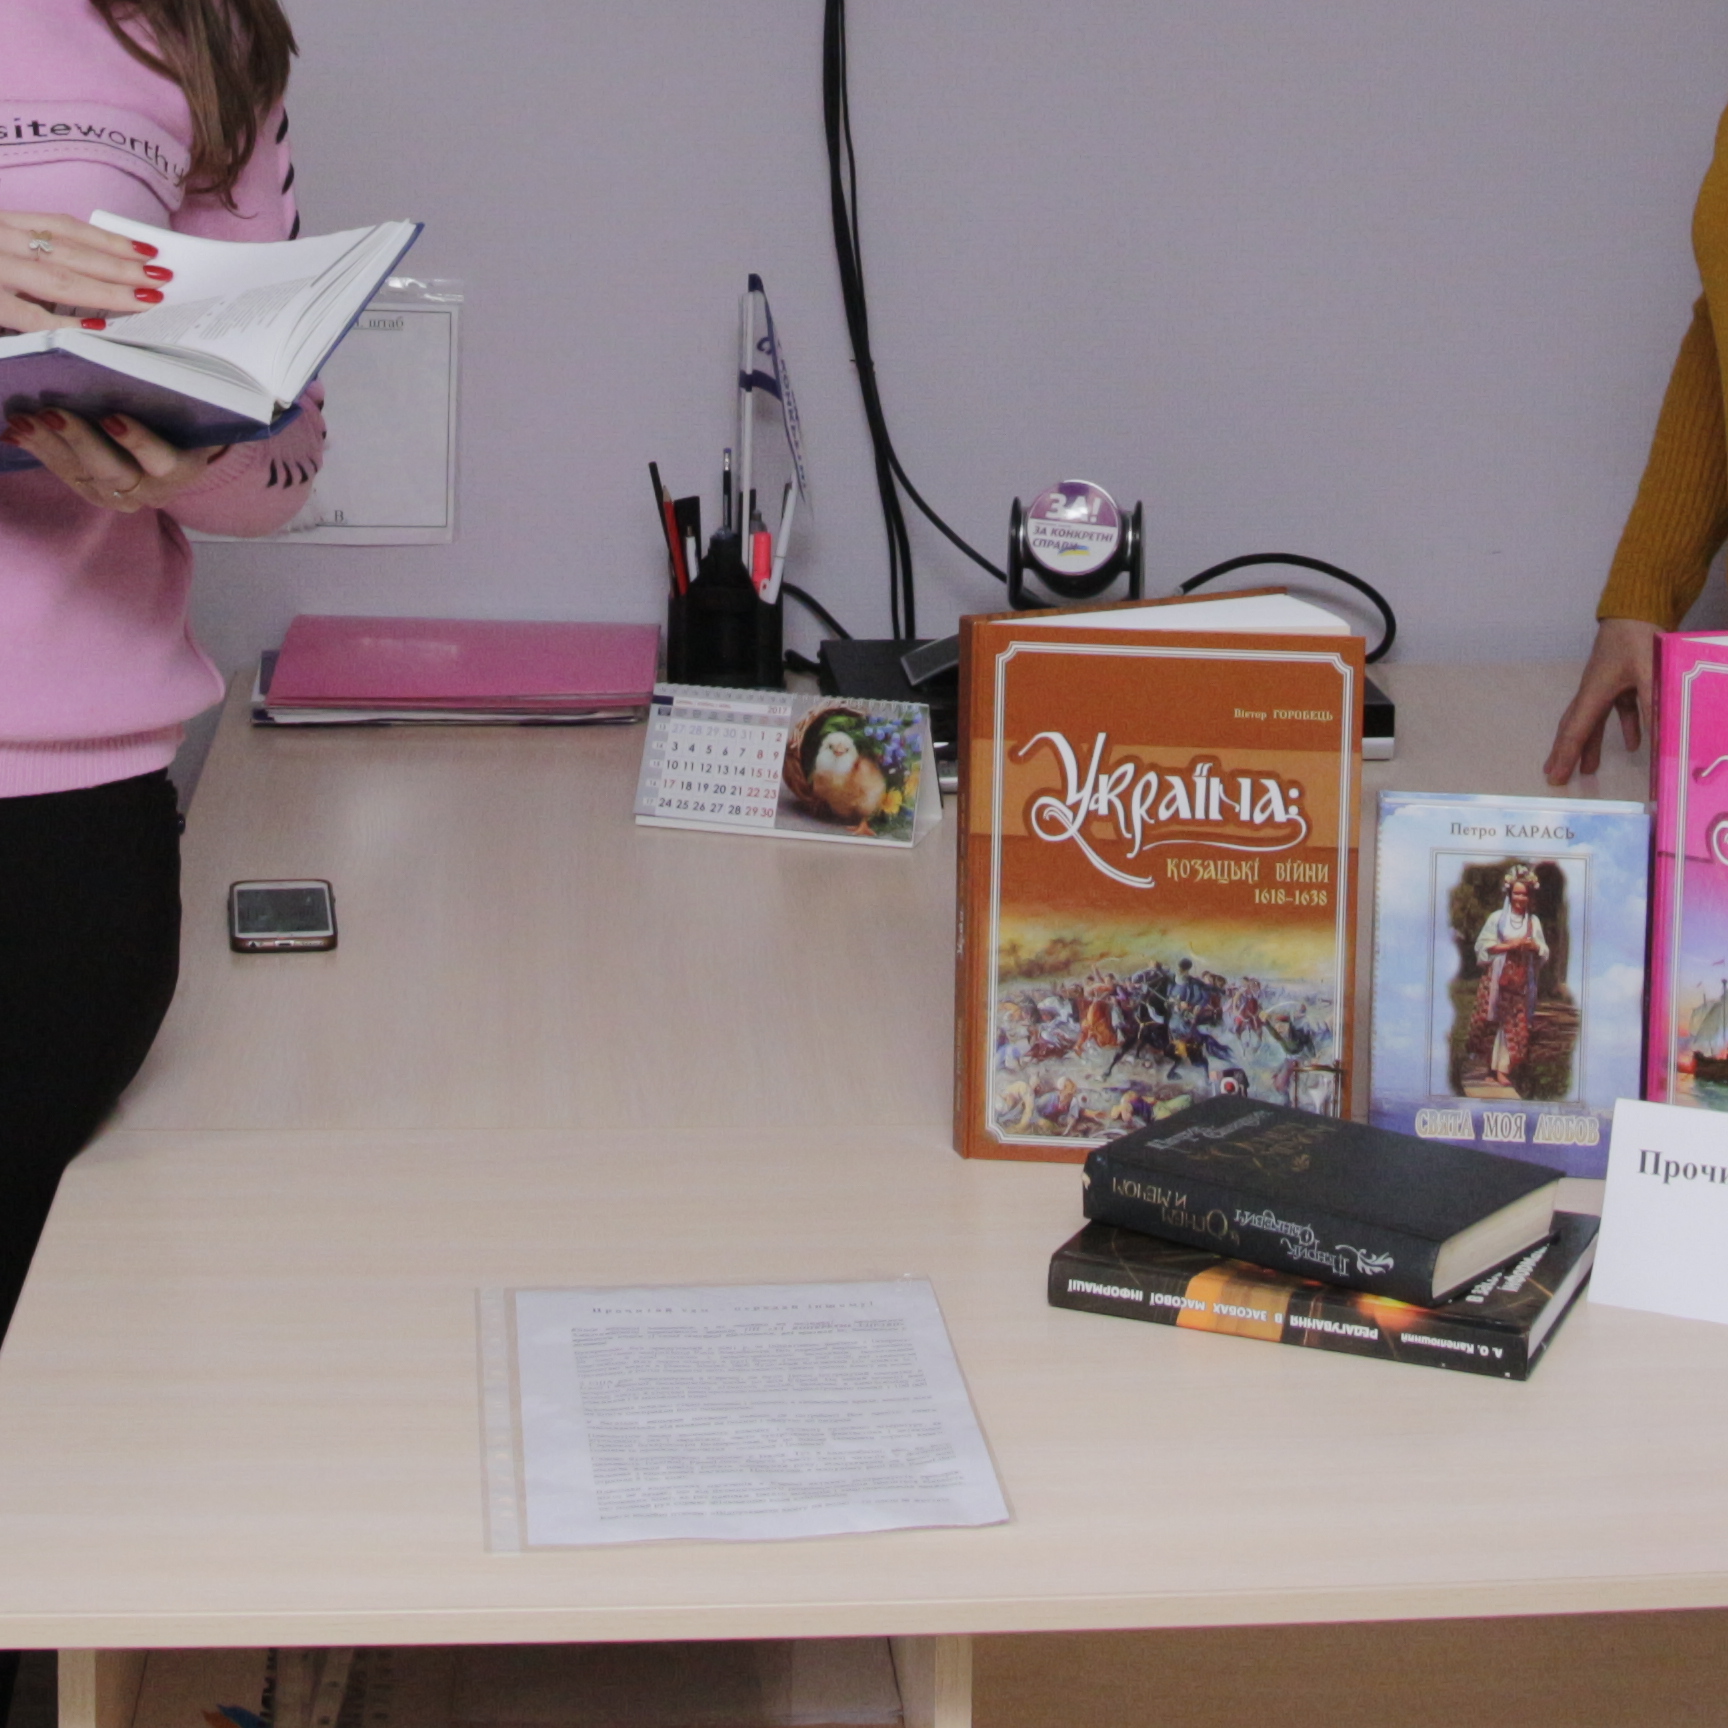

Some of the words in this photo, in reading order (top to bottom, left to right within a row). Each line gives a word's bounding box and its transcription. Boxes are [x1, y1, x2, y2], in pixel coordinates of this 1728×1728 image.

[1045, 493, 1101, 523] ЗА!
[1034, 526, 1047, 535] ЗА
[1051, 528, 1114, 542] КОНКРЕТНІ
[1234, 707, 1267, 721] Віктор
[1273, 709, 1334, 722] ГОРОБЕЦЬ
[761, 731, 765, 740] 1
[776, 732, 782, 742] 2
[672, 741, 678, 751] 3
[689, 743, 695, 752] 4
[706, 745, 712, 754] 5
[722, 747, 728, 756] 6
[739, 747, 746, 757] 7
[757, 749, 763, 760] 8
[773, 751, 779, 761] 9
[667, 760, 679, 770] 10
[684, 761, 694, 771] 11
[701, 763, 712, 773] 12
[717, 764, 729, 775] 13
[734, 765, 745, 776] 14
[751, 767, 762, 778] 15
[766, 769, 778, 779] 16
[663, 779, 676, 788] 17
[681, 781, 692, 791] 18
[697, 782, 709, 792] 19
[713, 784, 726, 794] 20
[730, 785, 742, 796] 21
[746, 787, 760, 798] 22
[763, 788, 777, 799] 23
[658, 797, 672, 808] 24
[676, 799, 689, 809] 25
[692, 801, 705, 811] 26
[710, 803, 724, 813] 27
[728, 804, 741, 815] 28
[745, 806, 759, 816] 29
[760, 807, 774, 818] 30
[1450, 822, 1497, 840] Петро
[1505, 824, 1575, 840] КАРАСЬ
[1415, 1108, 1475, 1140] СВЯТА
[1482, 1111, 1526, 1143] МОЯ
[1533, 1113, 1600, 1146] ЛЮБОВ
[1067, 1278, 1143, 1302] ІНФОРМАЦІЇ
[1149, 1292, 1206, 1311] МАСОВОЇ
[1213, 1303, 1268, 1322] ЗАСОБАХ
[1289, 1315, 1379, 1341] РЕДАГУВАННЯ
[1400, 1332, 1475, 1355] Капелюшний
[1476, 1343, 1489, 1357] О.
